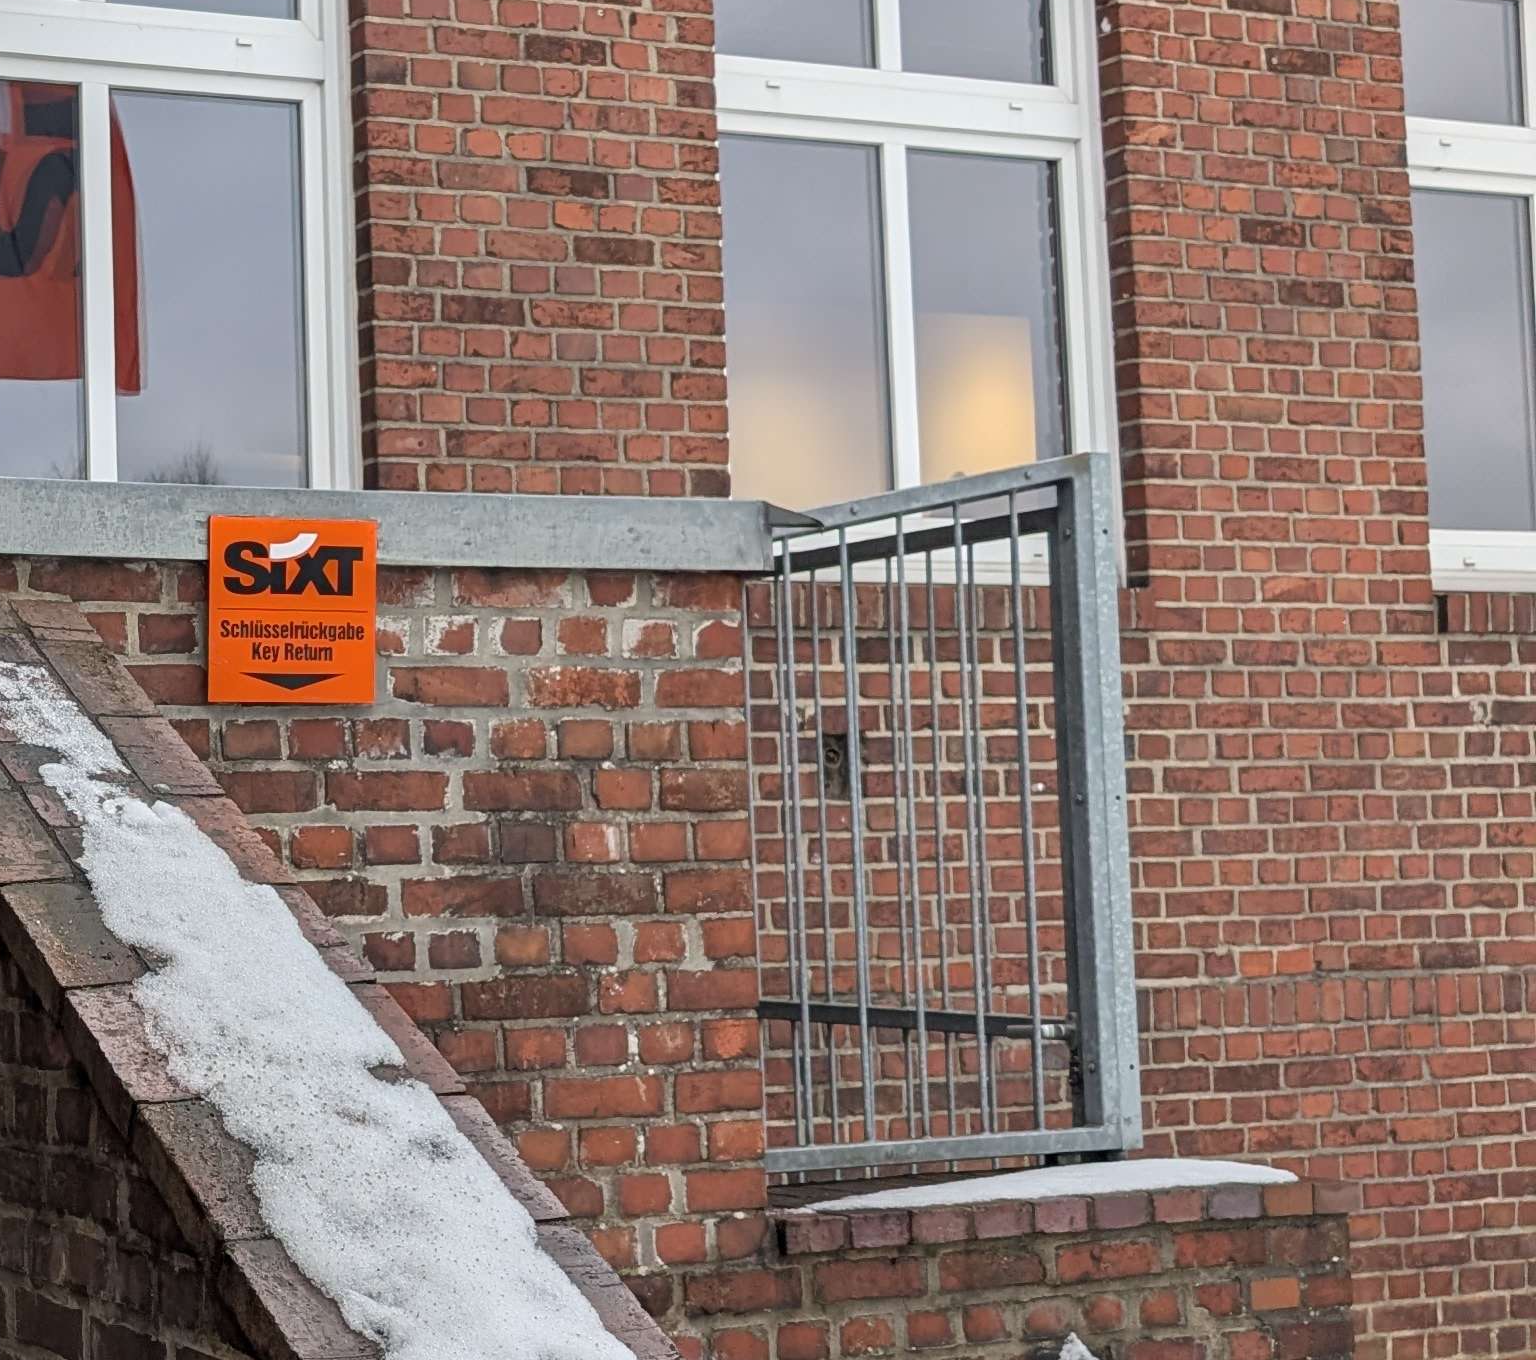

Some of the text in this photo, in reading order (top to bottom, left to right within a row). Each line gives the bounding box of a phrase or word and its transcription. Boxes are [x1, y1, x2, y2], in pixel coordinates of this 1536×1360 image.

[220, 619, 365, 642] Schlüsselrückgabe
[251, 642, 333, 663] Key Return
